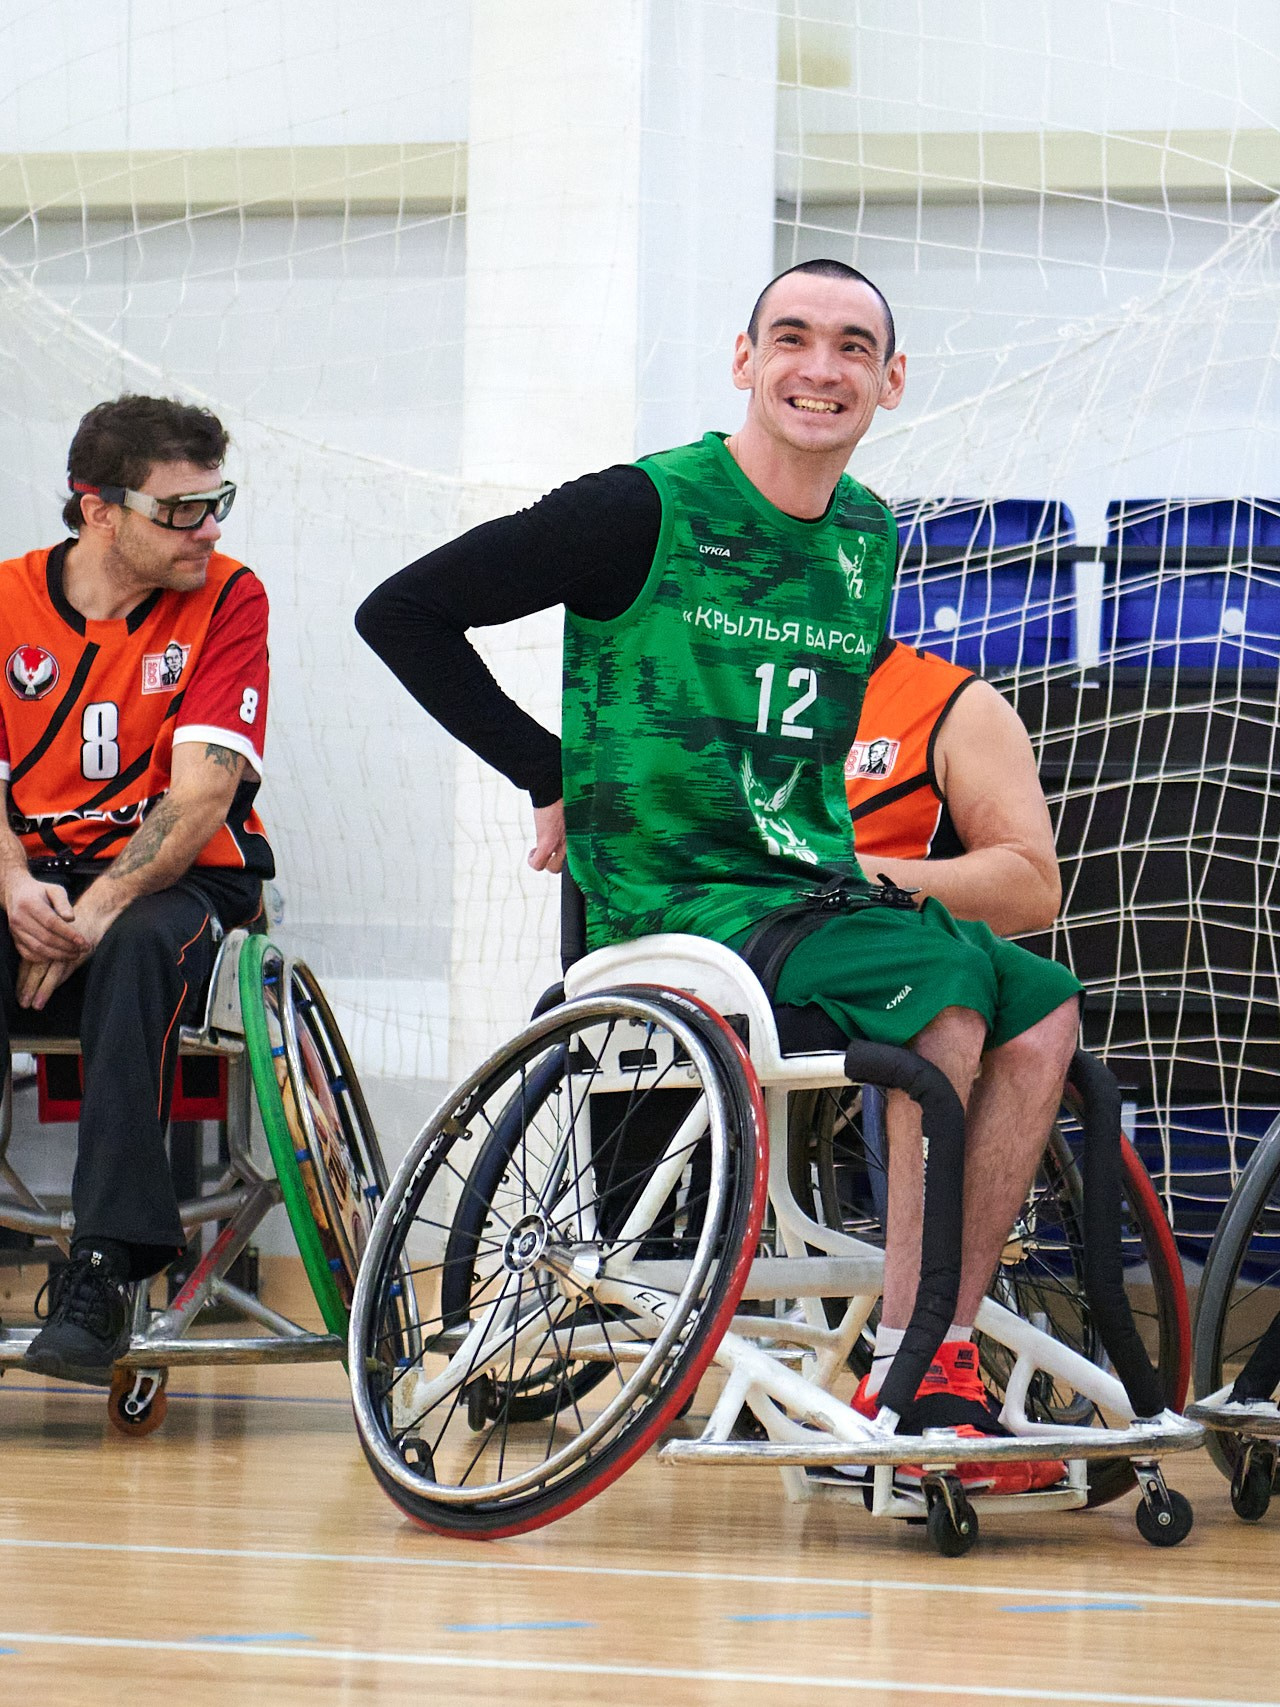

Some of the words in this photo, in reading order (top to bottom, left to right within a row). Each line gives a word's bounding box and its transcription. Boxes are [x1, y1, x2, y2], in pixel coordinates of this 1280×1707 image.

[699, 544, 731, 557] LYKIA
[682, 606, 800, 644] «КРЫЛЬЯ
[805, 625, 872, 656] БАРСА»
[239, 687, 259, 724] 8
[755, 662, 818, 740] 12
[80, 701, 121, 781] 8
[886, 985, 913, 1010] LYKIA
